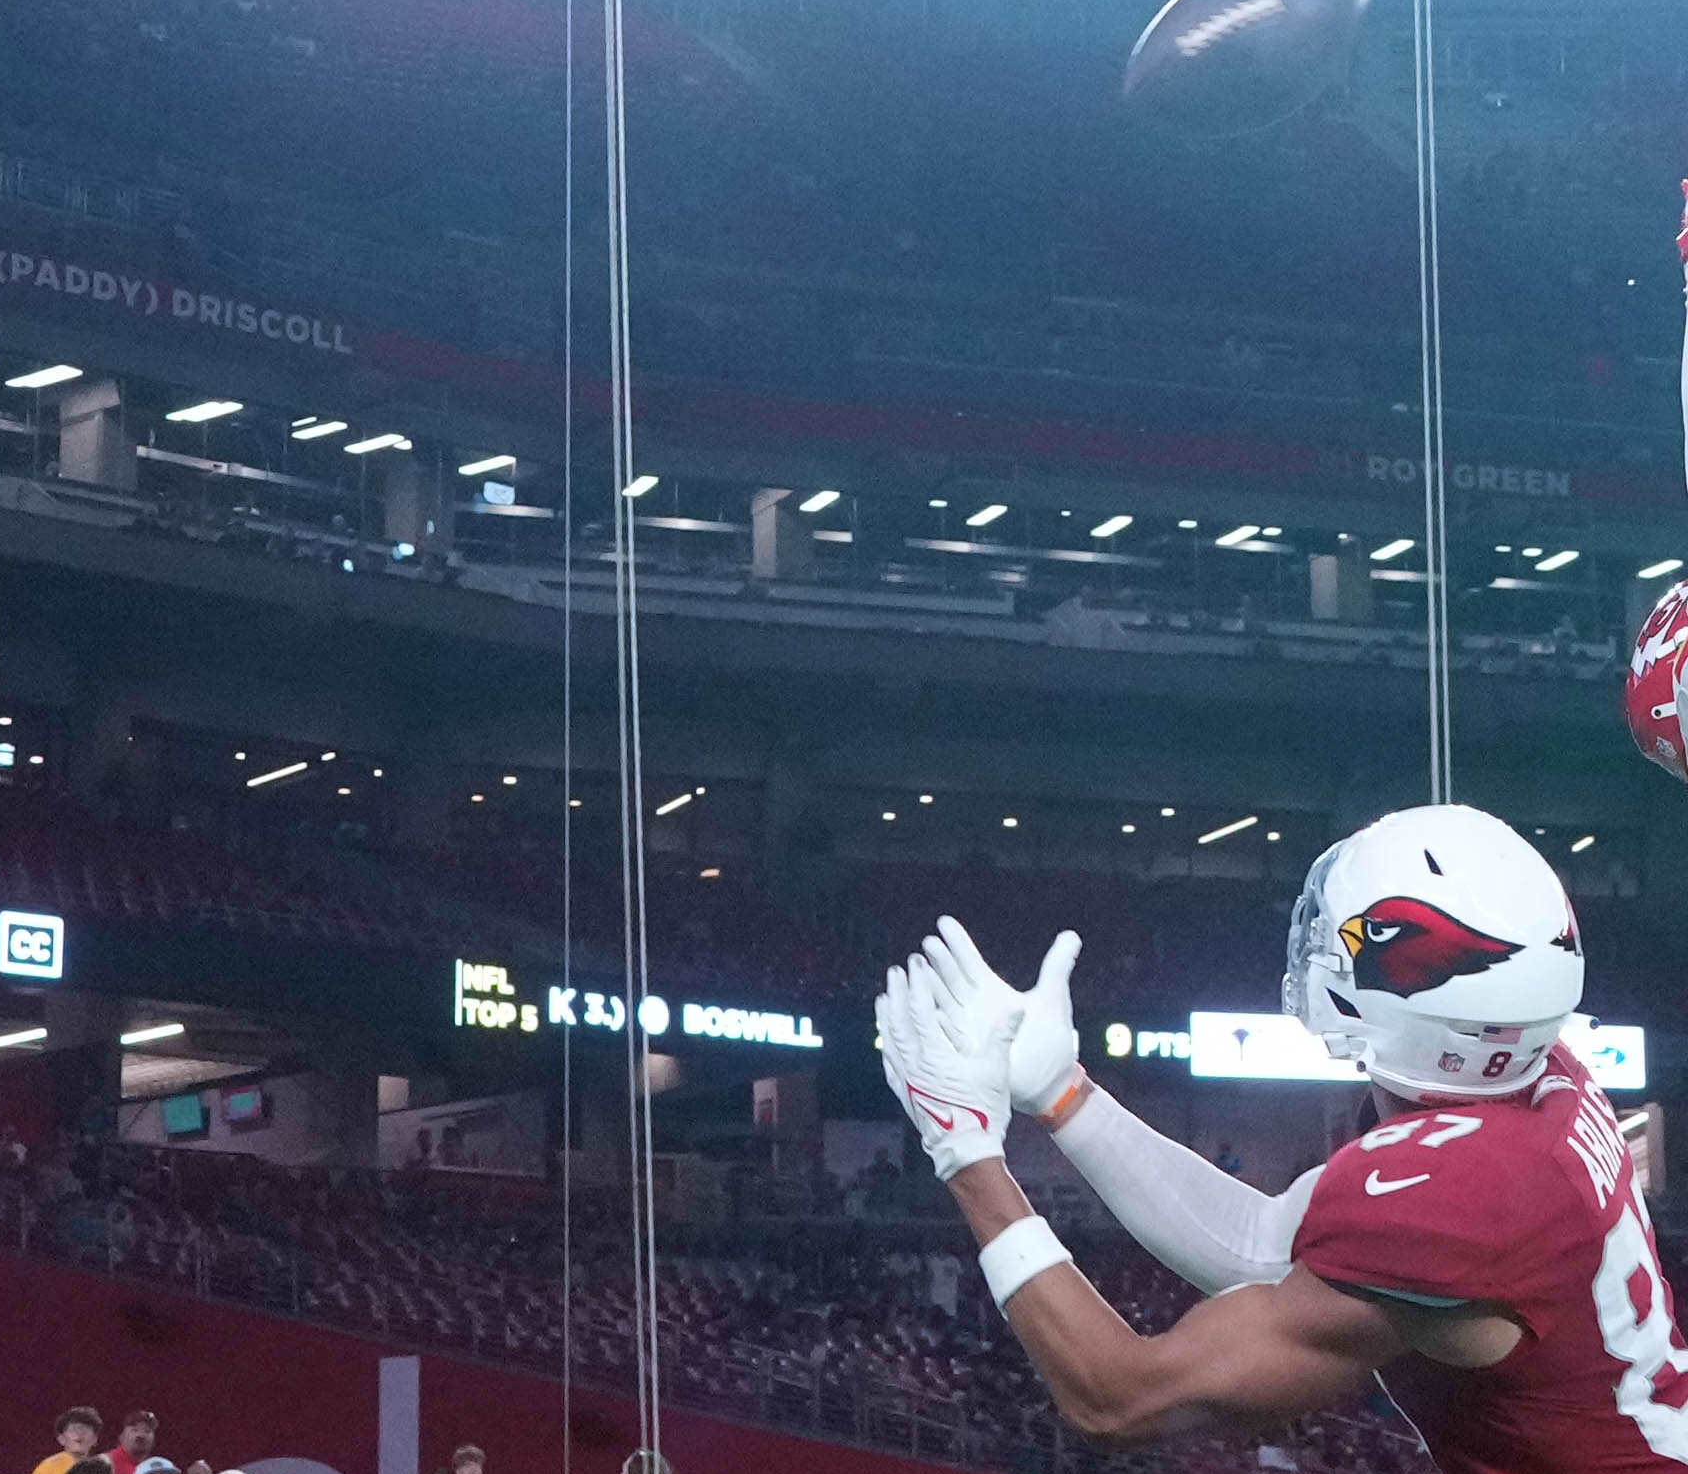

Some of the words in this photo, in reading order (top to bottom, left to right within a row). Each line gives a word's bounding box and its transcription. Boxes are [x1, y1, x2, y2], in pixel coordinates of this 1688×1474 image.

[171, 288, 353, 354] DRISCOLL
[10, 928, 52, 963] CC
[463, 963, 514, 996] NFL
[464, 998, 518, 1029] TOP
[520, 1004, 538, 1032] 5
[549, 986, 576, 1025] K
[1105, 1022, 1132, 1058] 9
